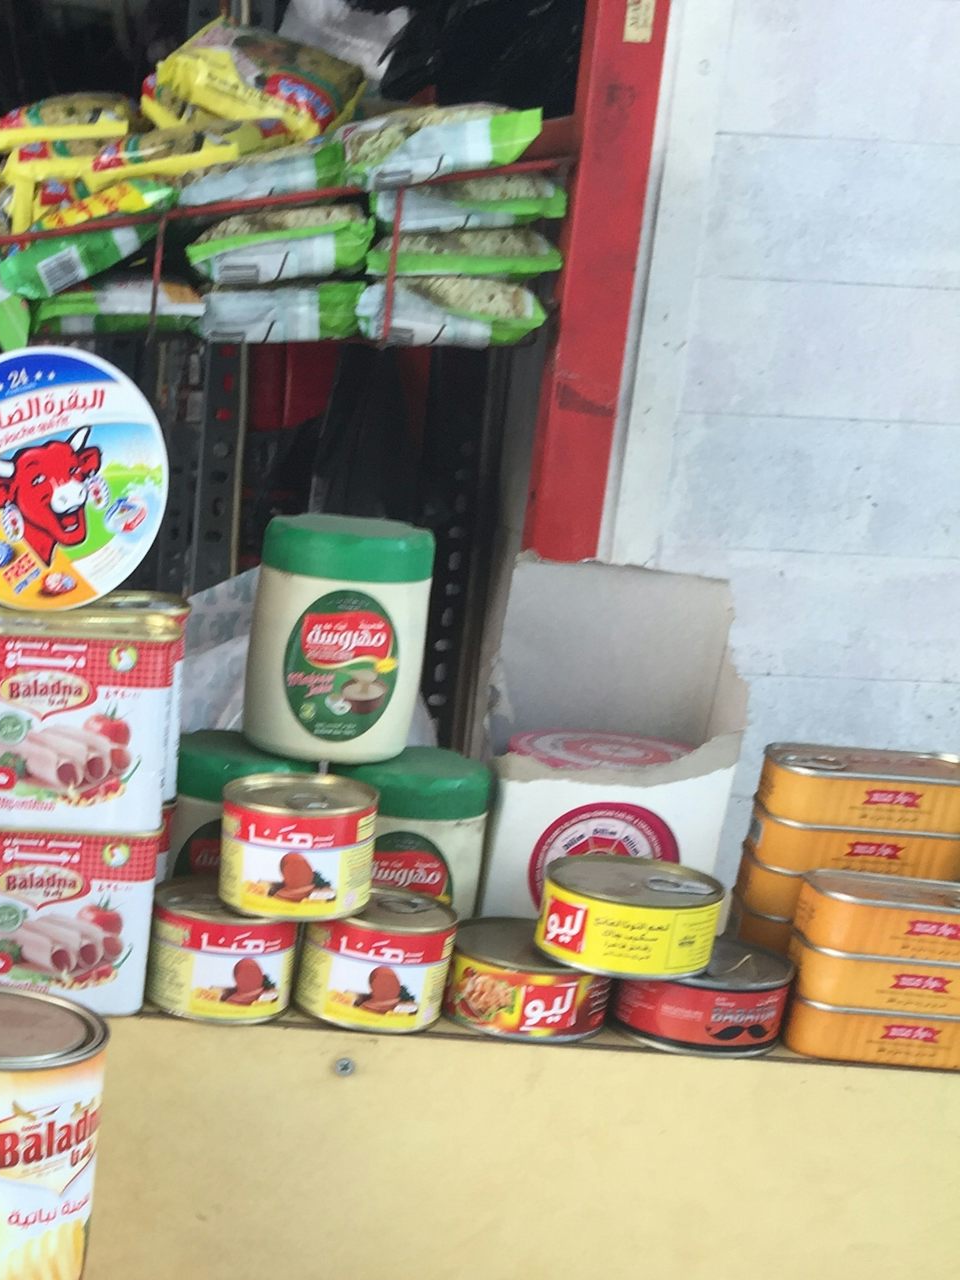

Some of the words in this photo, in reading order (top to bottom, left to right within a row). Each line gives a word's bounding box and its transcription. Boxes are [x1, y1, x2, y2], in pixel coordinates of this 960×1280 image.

[44, 389, 106, 416] البقرة
[307, 624, 387, 651] مهروسة
[545, 906, 585, 945] ليو
[524, 983, 576, 1026] ليو
